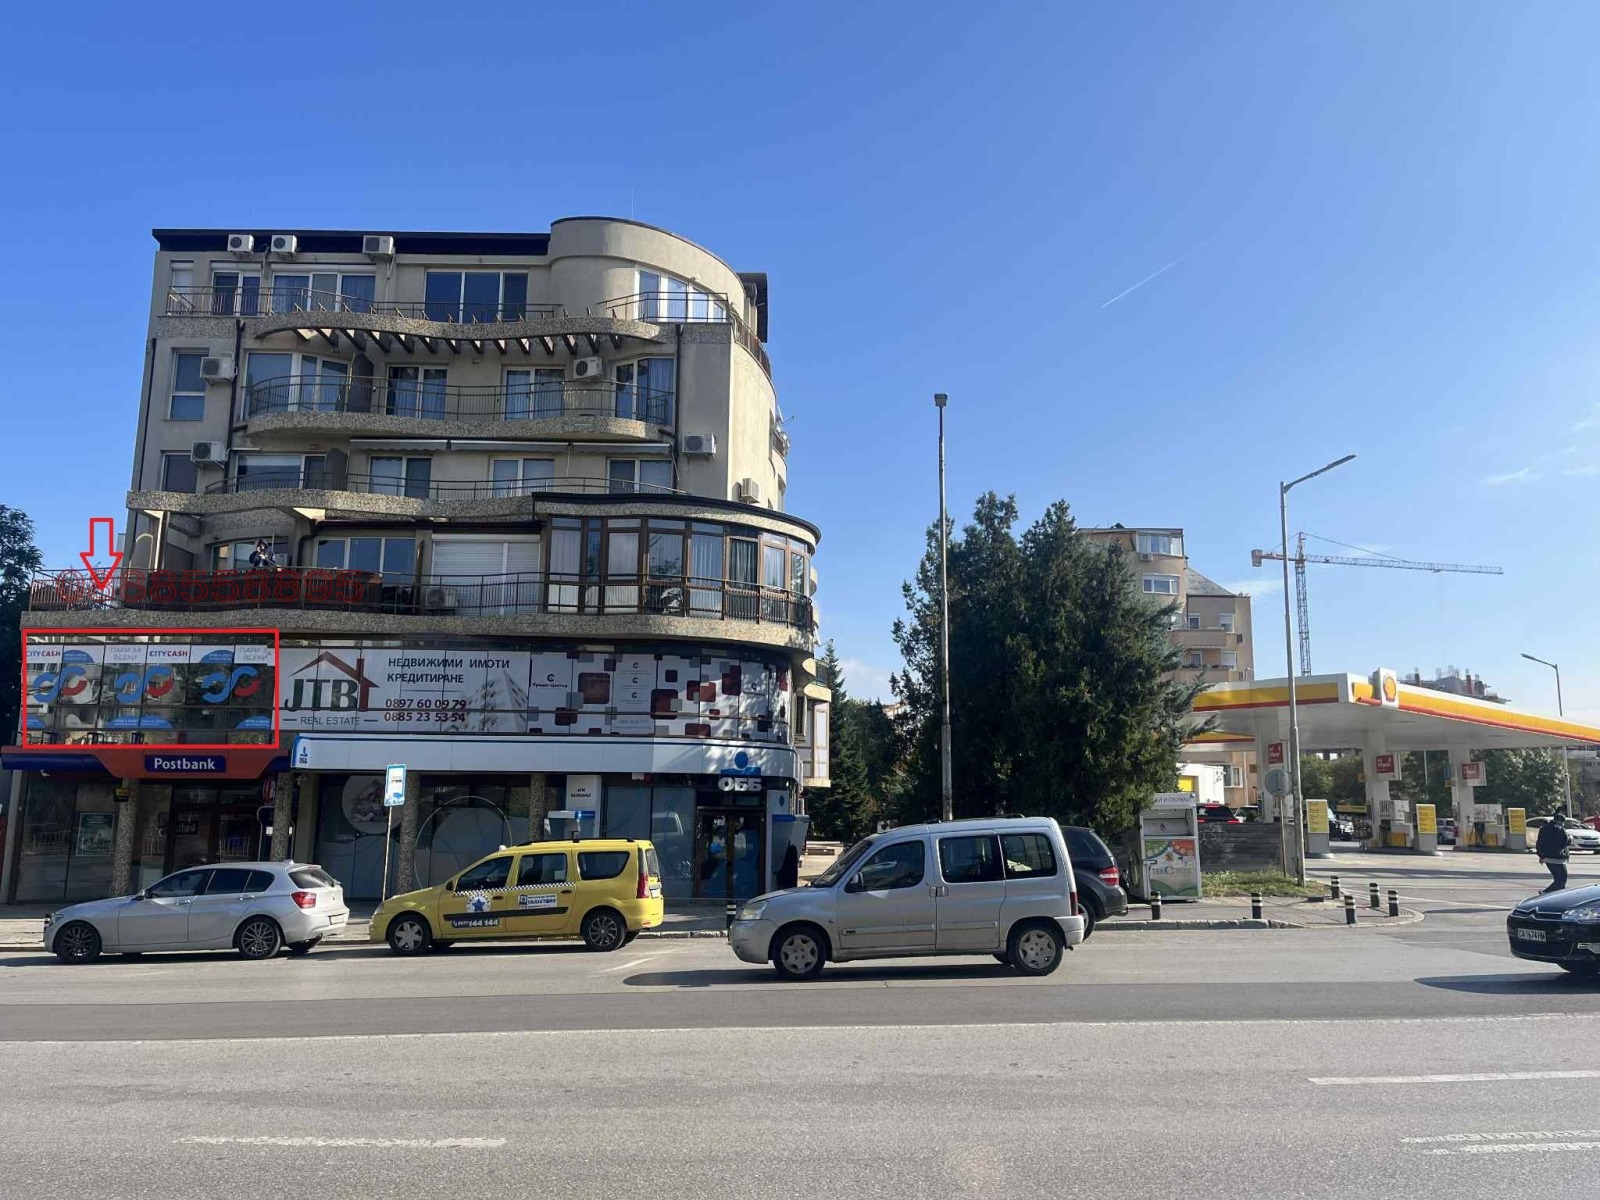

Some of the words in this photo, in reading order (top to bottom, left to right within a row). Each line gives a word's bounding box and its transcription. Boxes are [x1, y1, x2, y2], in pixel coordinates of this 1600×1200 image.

[388, 657, 463, 669] НЕДВИЖИМИ
[469, 659, 511, 669] ИМОТИ
[387, 673, 464, 684] КРЕДИТИРАНЕ
[284, 678, 358, 711] JTB
[385, 698, 413, 709] 0897
[416, 698, 432, 709] 60
[300, 716, 324, 726] REAL
[326, 716, 360, 726] ESTATE
[384, 712, 413, 722] 0885
[416, 712, 431, 722] 23
[434, 712, 449, 723] 53
[154, 757, 216, 770] Postbank
[717, 776, 762, 792] ОББ
